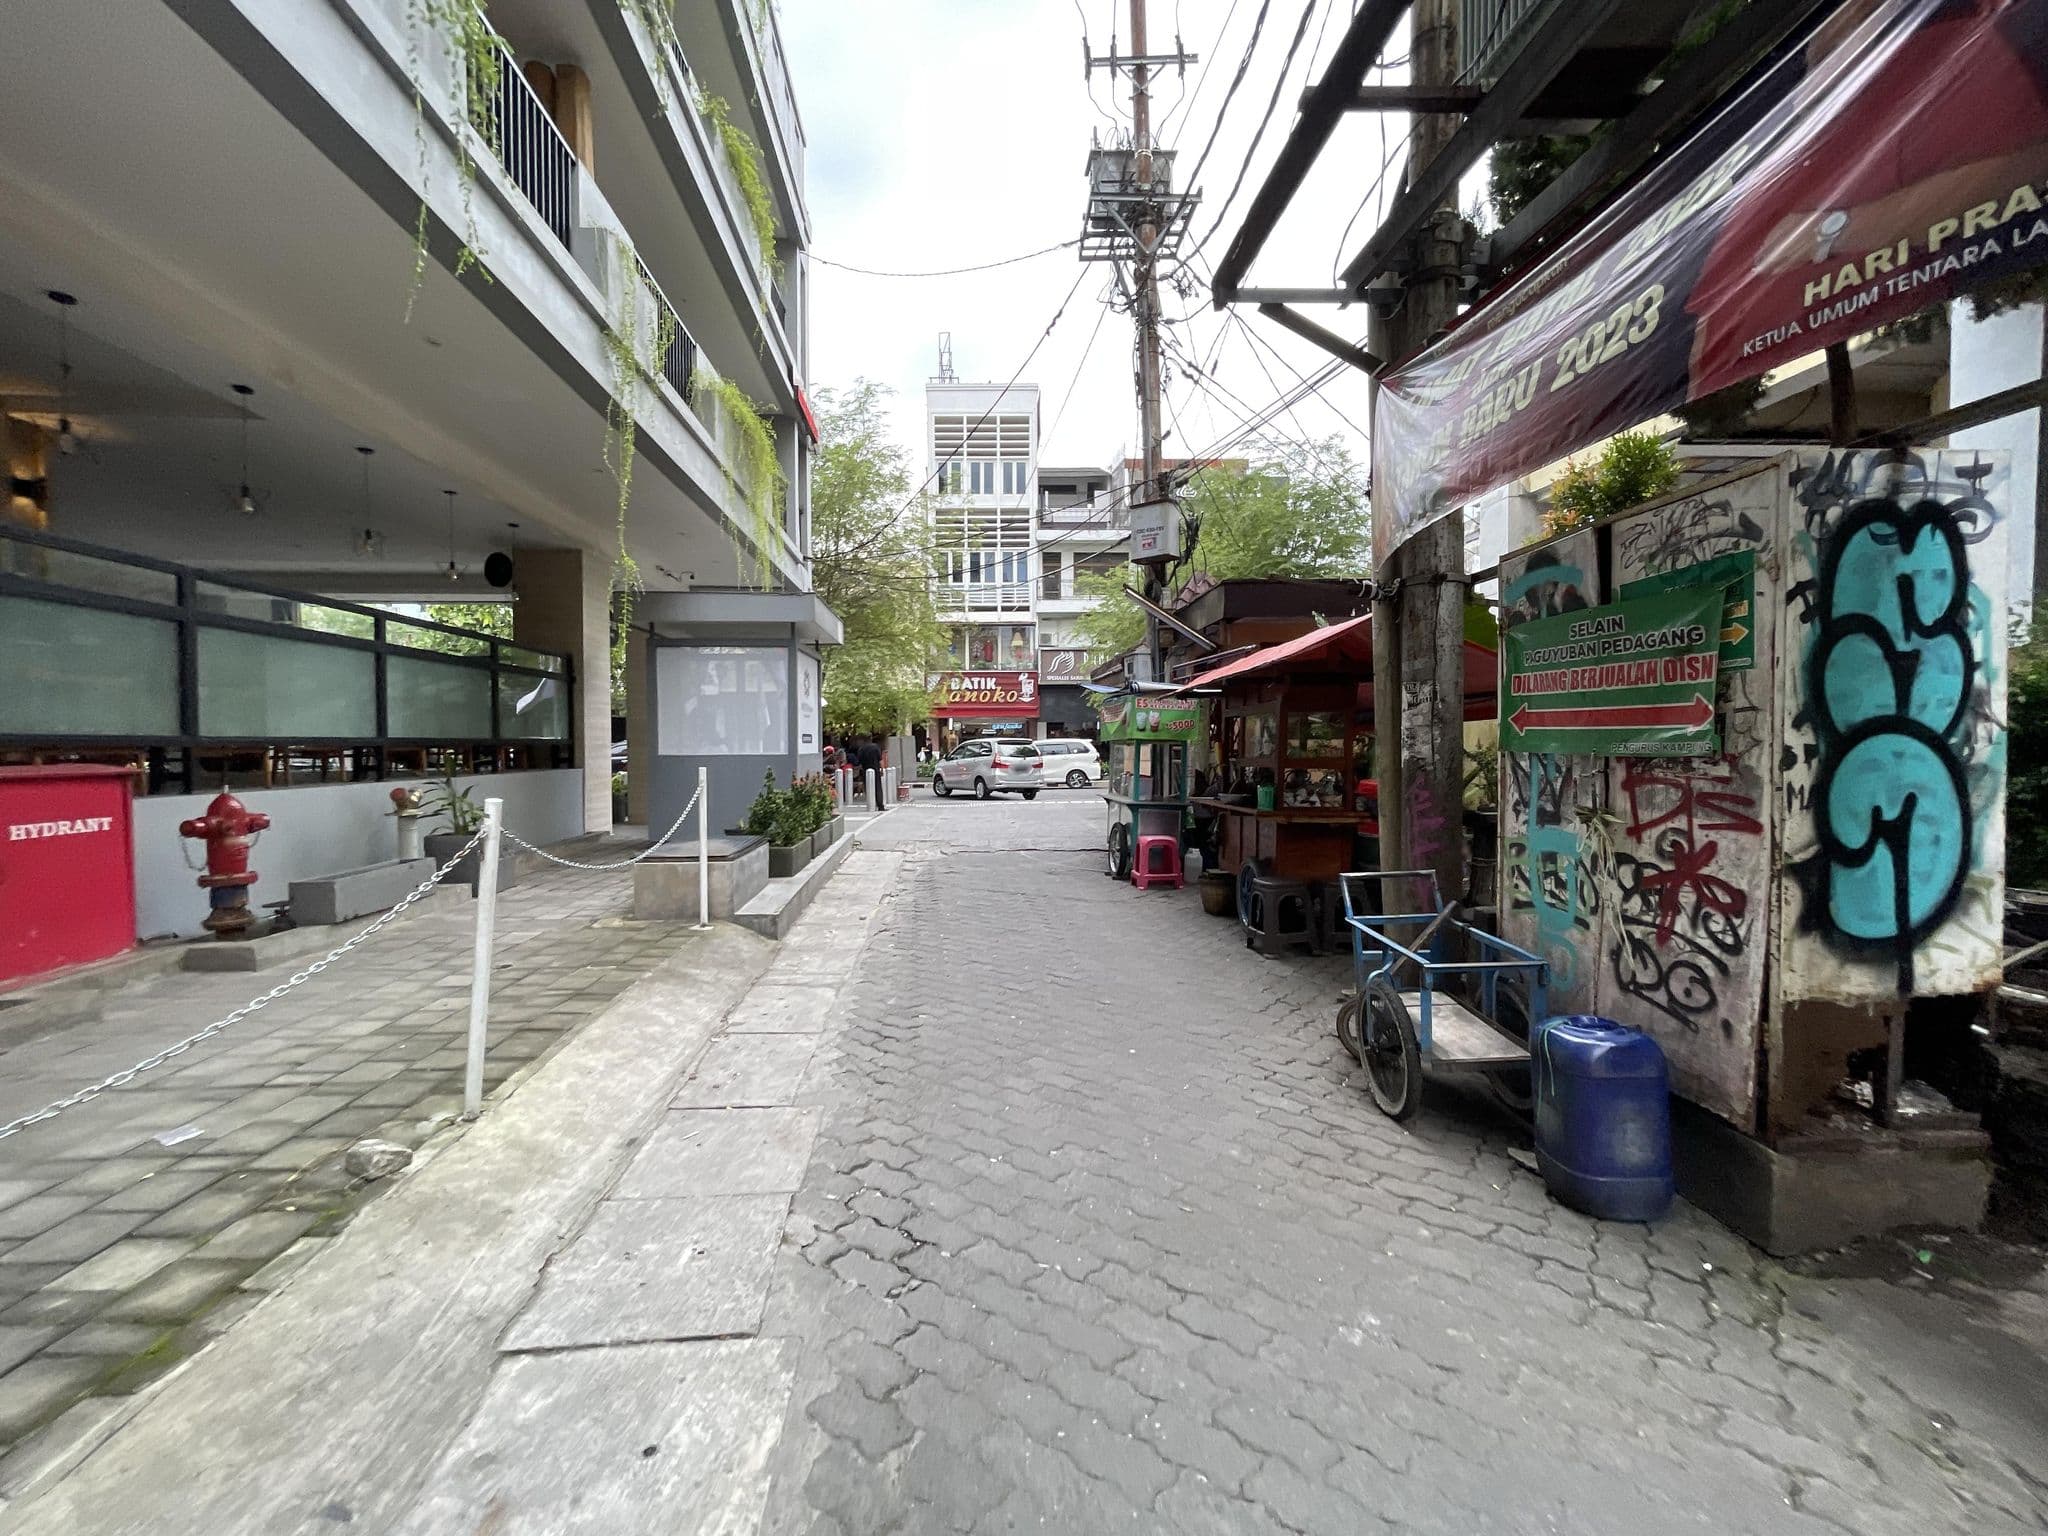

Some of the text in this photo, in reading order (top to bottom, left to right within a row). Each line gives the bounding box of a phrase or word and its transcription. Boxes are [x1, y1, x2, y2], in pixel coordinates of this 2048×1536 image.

[1803, 180, 2048, 307] HARI PRA
[1743, 321, 1803, 358] KETUA
[1808, 285, 1879, 329] UMUM
[1886, 238, 2002, 297] TENTARA
[1550, 283, 1665, 393] 2023
[1569, 614, 1625, 640] SELAIN
[1599, 624, 1706, 656] PEDAGANG
[950, 677, 997, 690] BATIK
[1511, 651, 1719, 697] DILARANG BERJUALAN DISN
[1136, 698, 1149, 709] ES
[1611, 741, 1713, 754] PENGURUS KAMPUNG
[8, 817, 113, 841] HYDRANT
